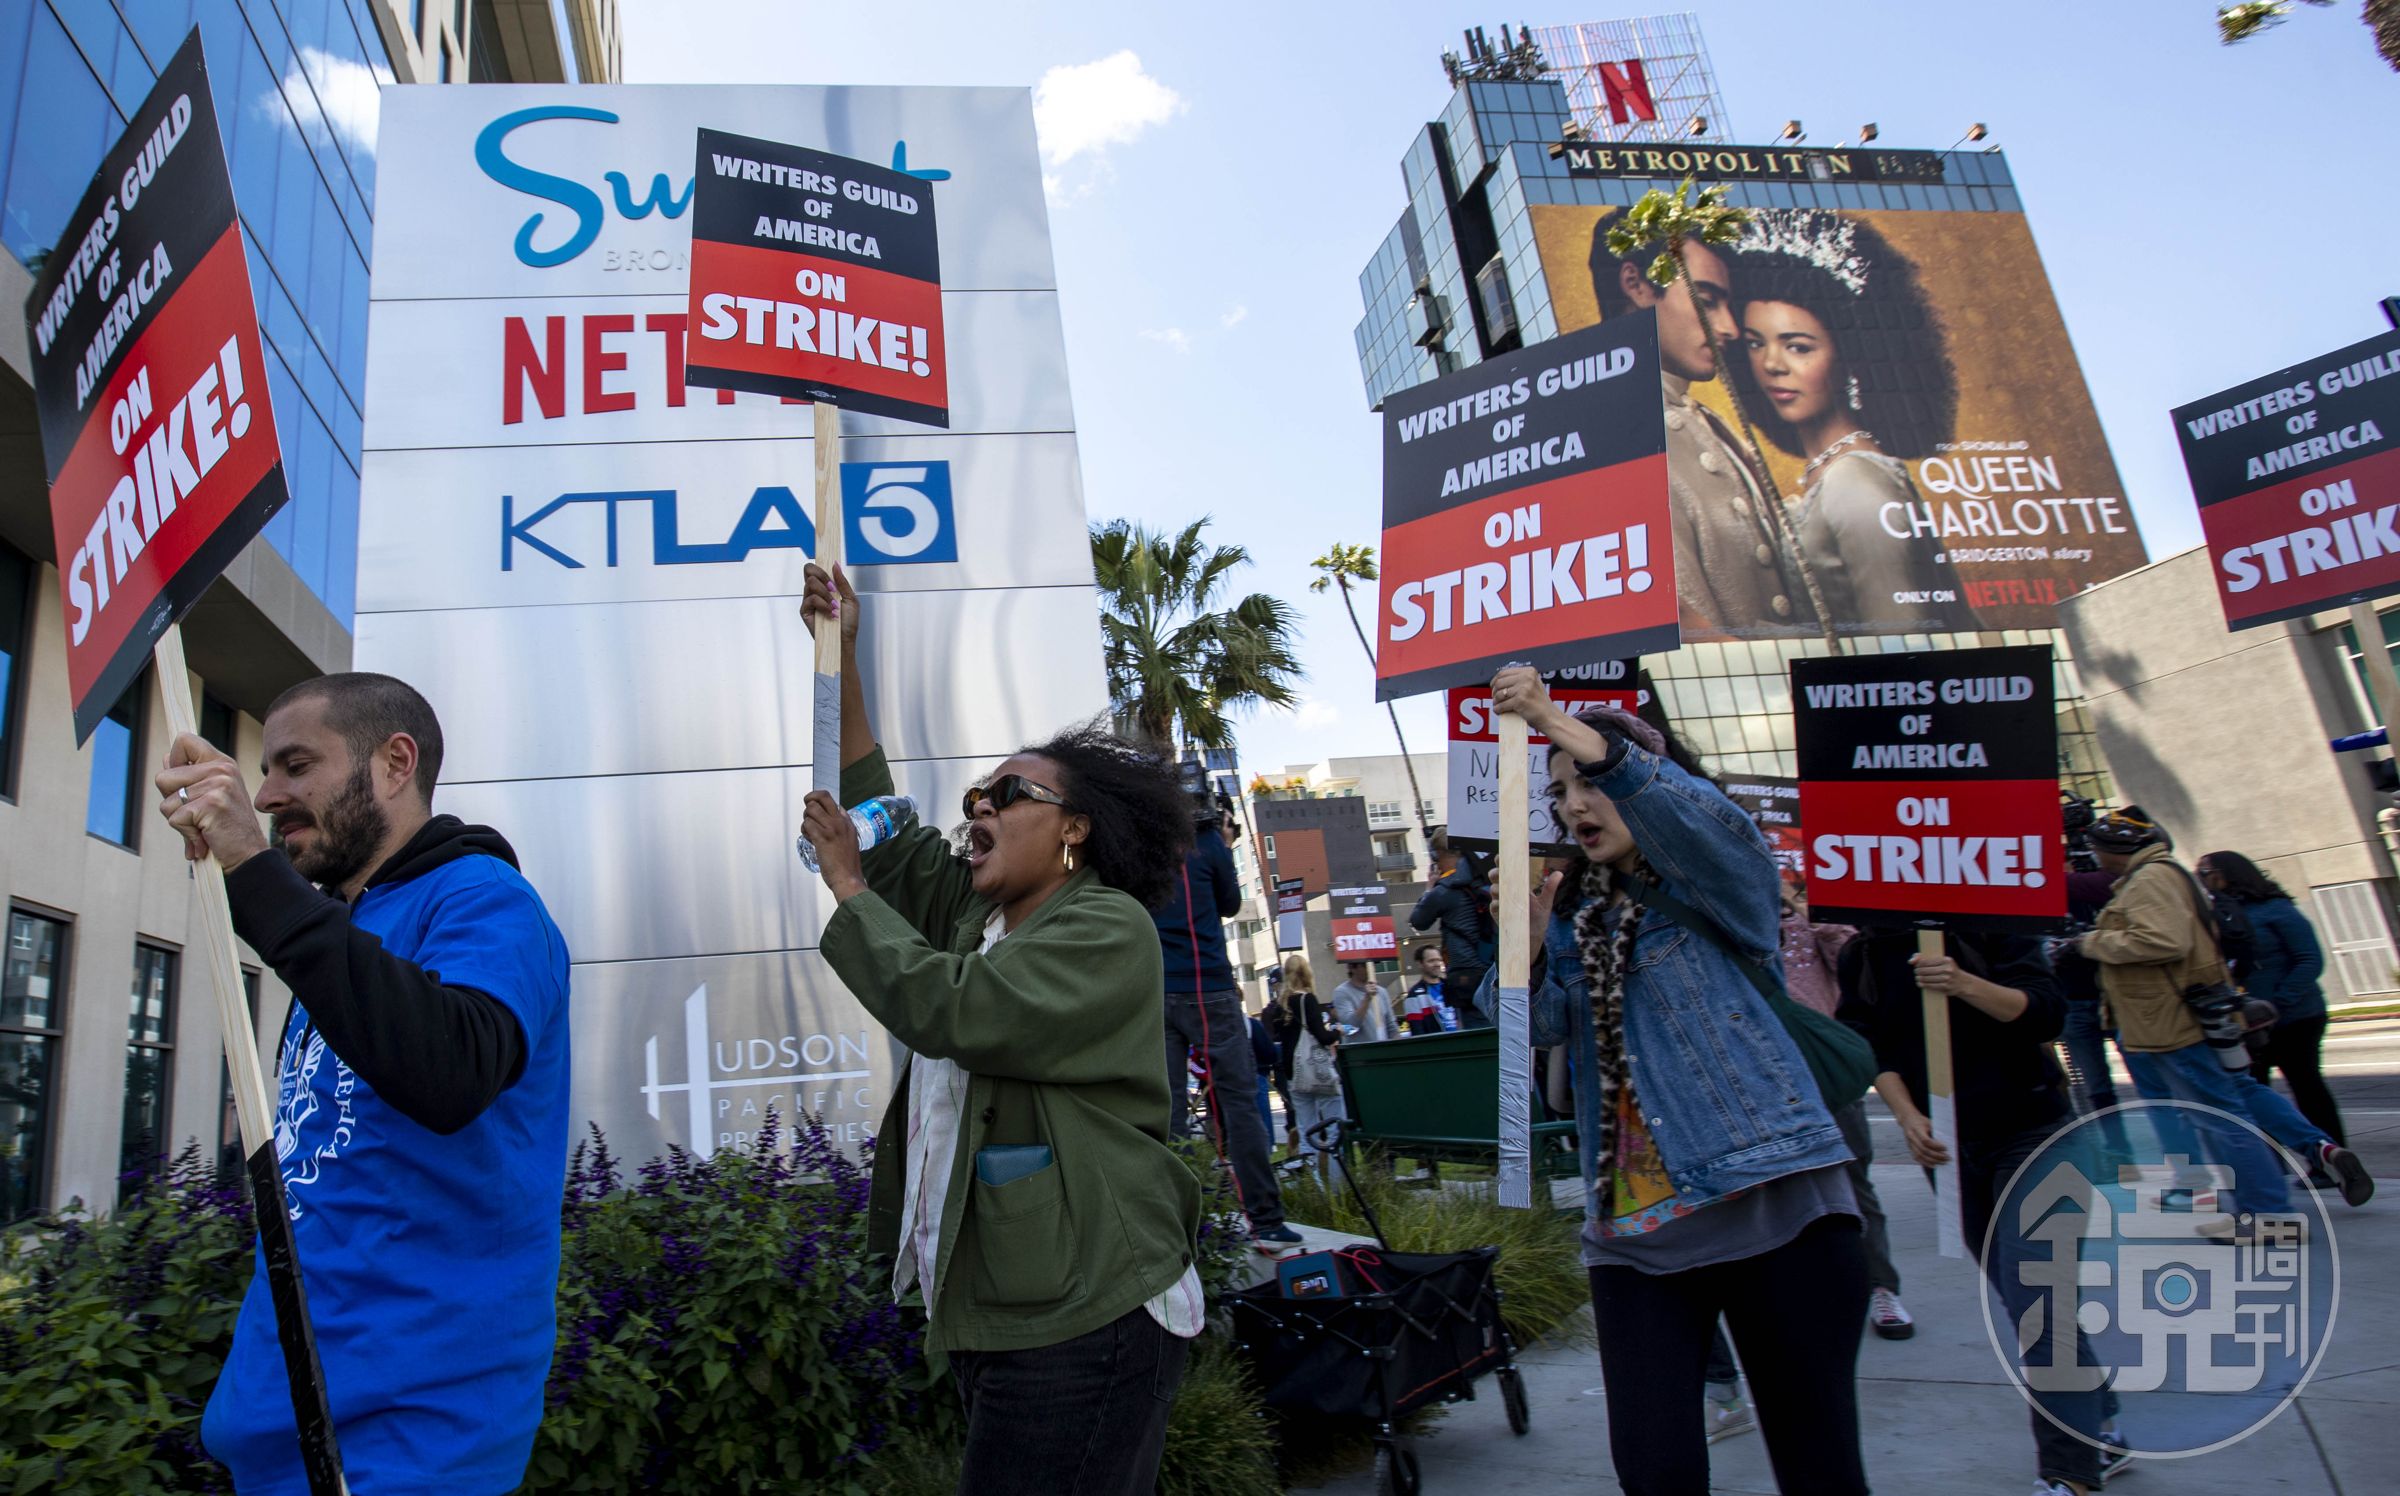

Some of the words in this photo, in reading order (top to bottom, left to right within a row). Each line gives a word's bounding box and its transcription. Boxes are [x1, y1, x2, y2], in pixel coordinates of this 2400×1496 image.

[1599, 59, 1656, 125] N
[712, 153, 837, 196] WRITERS
[843, 180, 919, 215] GUILD
[1568, 148, 1852, 174] METROPOLITN
[36, 203, 119, 357] WRITERS
[120, 93, 193, 204] GUILD
[803, 199, 833, 219] OF
[753, 216, 882, 260] AMERICA
[98, 255, 123, 302] OF
[795, 269, 846, 303] ON
[75, 240, 173, 412] AMERICA
[700, 293, 932, 379] STRIKE!
[110, 365, 154, 457] ON
[1398, 376, 1532, 445] WRITERS
[1536, 346, 1636, 401] GUILD
[2187, 381, 2316, 441] WRITERS
[1492, 414, 1526, 443] OF
[2286, 409, 2318, 435] OF
[1440, 432, 1586, 499] AMERICA
[2247, 419, 2384, 480] AMERICA
[68, 333, 252, 648] STRIKE!
[1920, 455, 2063, 500] QUEEN
[2300, 479, 2357, 517] ON
[501, 486, 818, 572] KTLA
[858, 467, 940, 558] 5
[1483, 503, 1542, 550] ON
[1879, 497, 2128, 539] CHARLOTTE
[1950, 547, 2049, 563] BRIDGERTON
[2052, 547, 2093, 563] story
[1389, 523, 1653, 642] STRIKE!
[1893, 590, 1931, 604] ONLY
[1932, 590, 1957, 603] ON
[1963, 578, 2060, 609] NETFLIX
[1806, 681, 1936, 709] WRITERS
[1941, 676, 2034, 706] GUILD
[1900, 715, 1932, 736] OF
[1852, 742, 1988, 770] AMERICA
[1896, 797, 1950, 827] ON
[1813, 834, 2045, 889] STRIKE!
[640, 981, 868, 1162] HUDSON
[717, 1087, 871, 1118] PACIFIC
